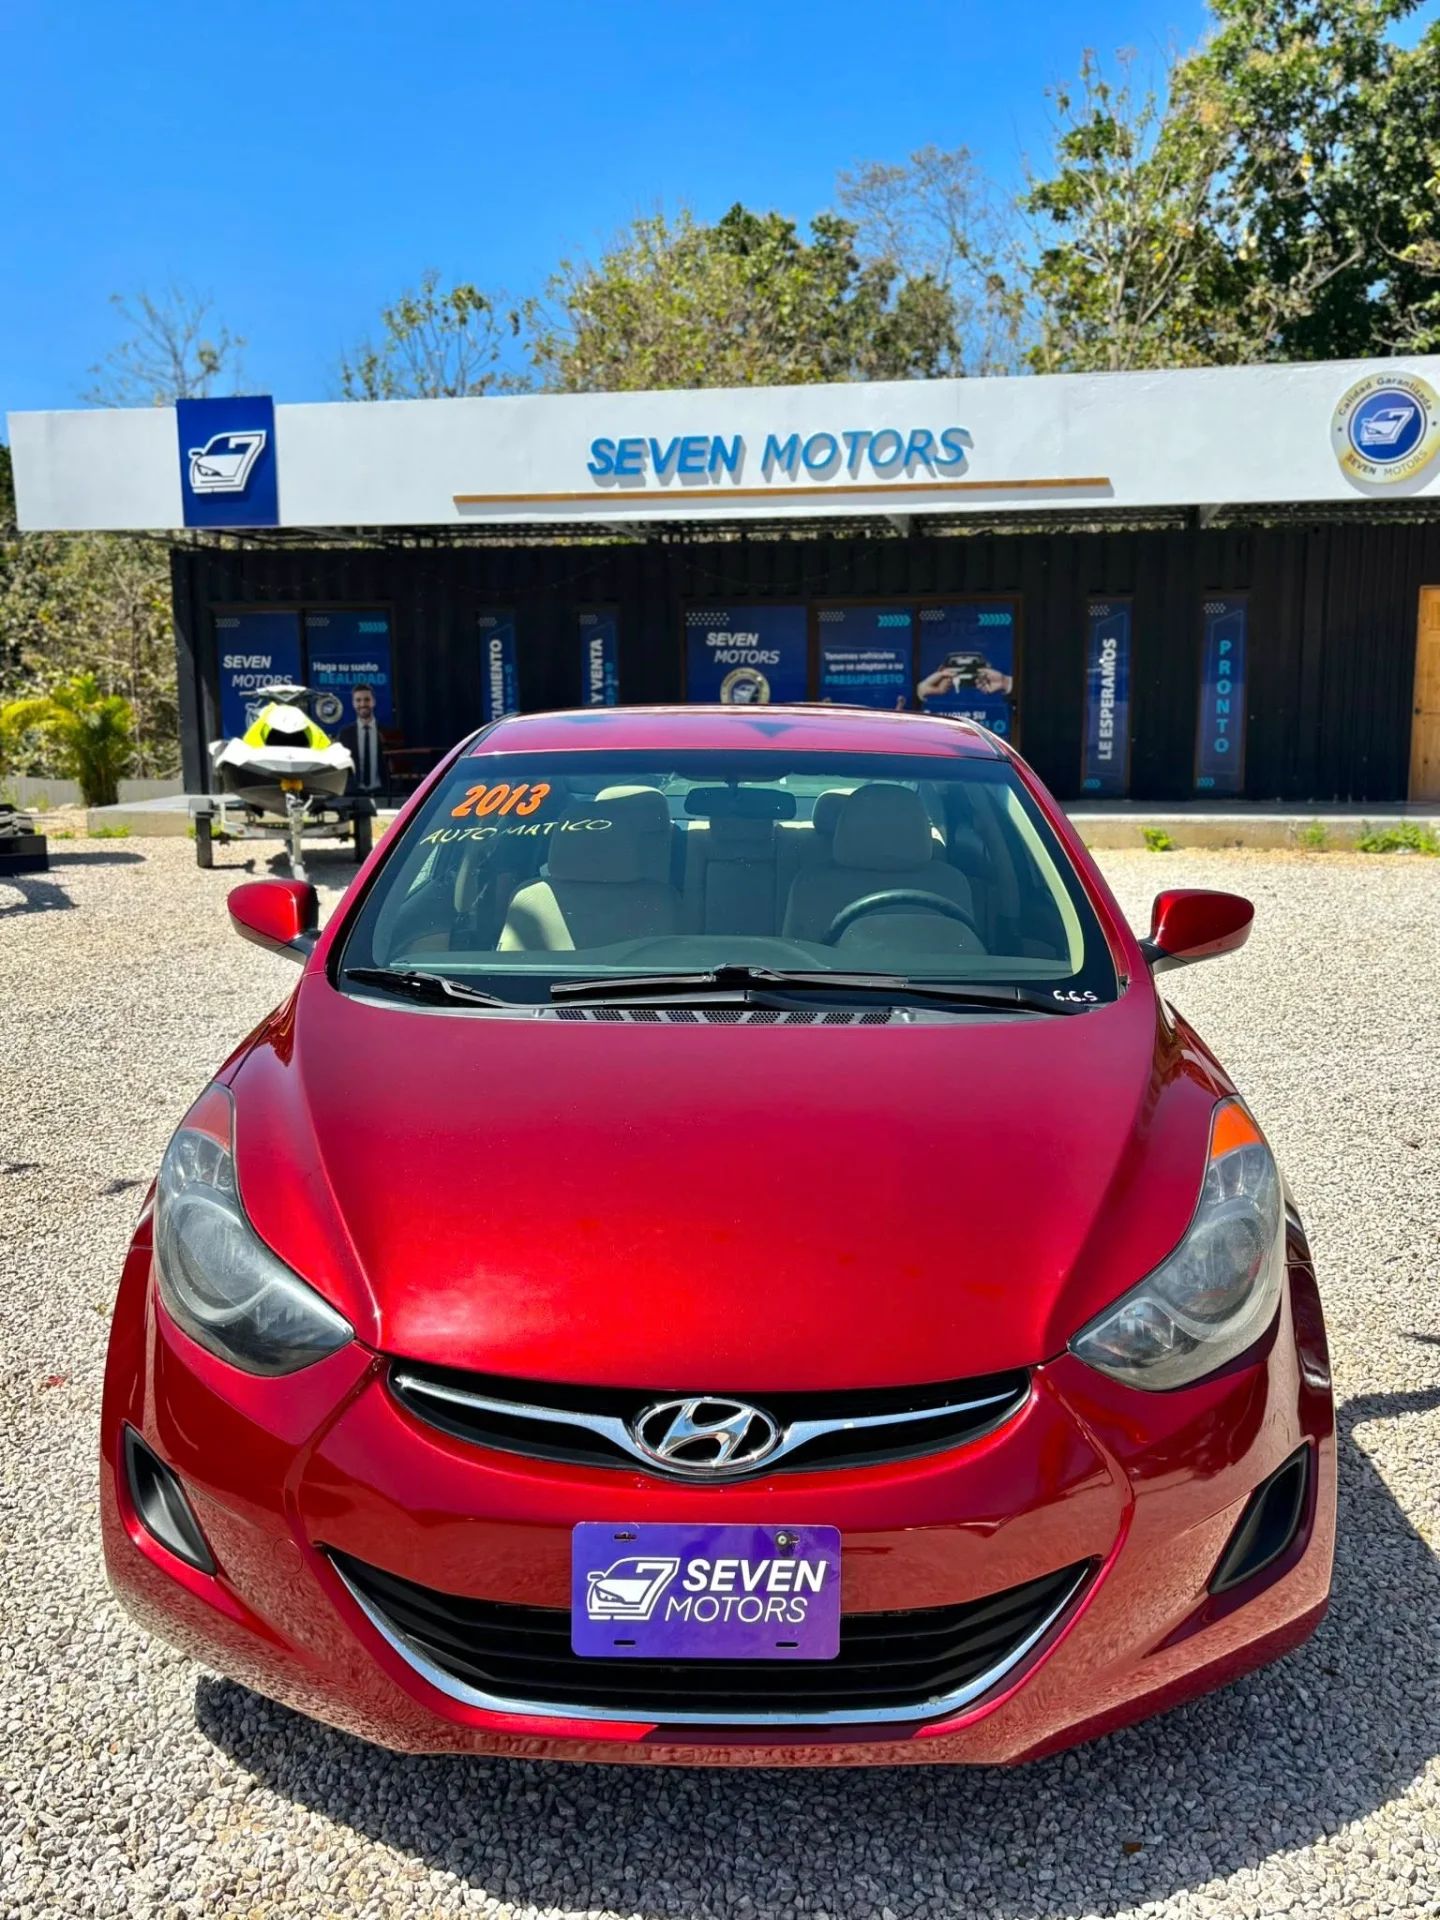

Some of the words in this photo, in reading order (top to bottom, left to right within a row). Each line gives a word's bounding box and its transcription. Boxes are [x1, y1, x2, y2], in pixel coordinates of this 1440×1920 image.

[1338, 382, 1372, 416] Calidad
[1377, 377, 1432, 411] Garantizada
[587, 434, 742, 476] SEVEN
[761, 427, 971, 472] MOTORS
[1346, 454, 1377, 475] SEVEN
[1383, 449, 1428, 477] MOTORS
[705, 632, 759, 646] SEVEN
[223, 655, 272, 669] SEVEN
[590, 638, 604, 691] VENTA
[714, 650, 780, 664] MOTORS
[824, 652, 858, 661] Tenemos
[313, 662, 335, 673] Haga
[338, 664, 348, 672] su
[350, 662, 378, 672] sueño
[830, 664, 845, 673] que
[846, 663, 855, 671] se
[894, 663, 905, 671] su
[232, 674, 292, 688] MOTORS
[320, 673, 386, 684] REALIDAD
[824, 674, 905, 685] PRESUPUESTO
[1099, 638, 1117, 738] ESPERAMOS
[591, 692, 604, 703] Y
[1214, 639, 1232, 753] PRONTO
[1097, 741, 1113, 760] LE
[451, 783, 551, 816] 2013
[420, 819, 613, 845] AUTOMATICO
[682, 1558, 828, 1593] SEVEN
[665, 1596, 808, 1623] MOTORS
